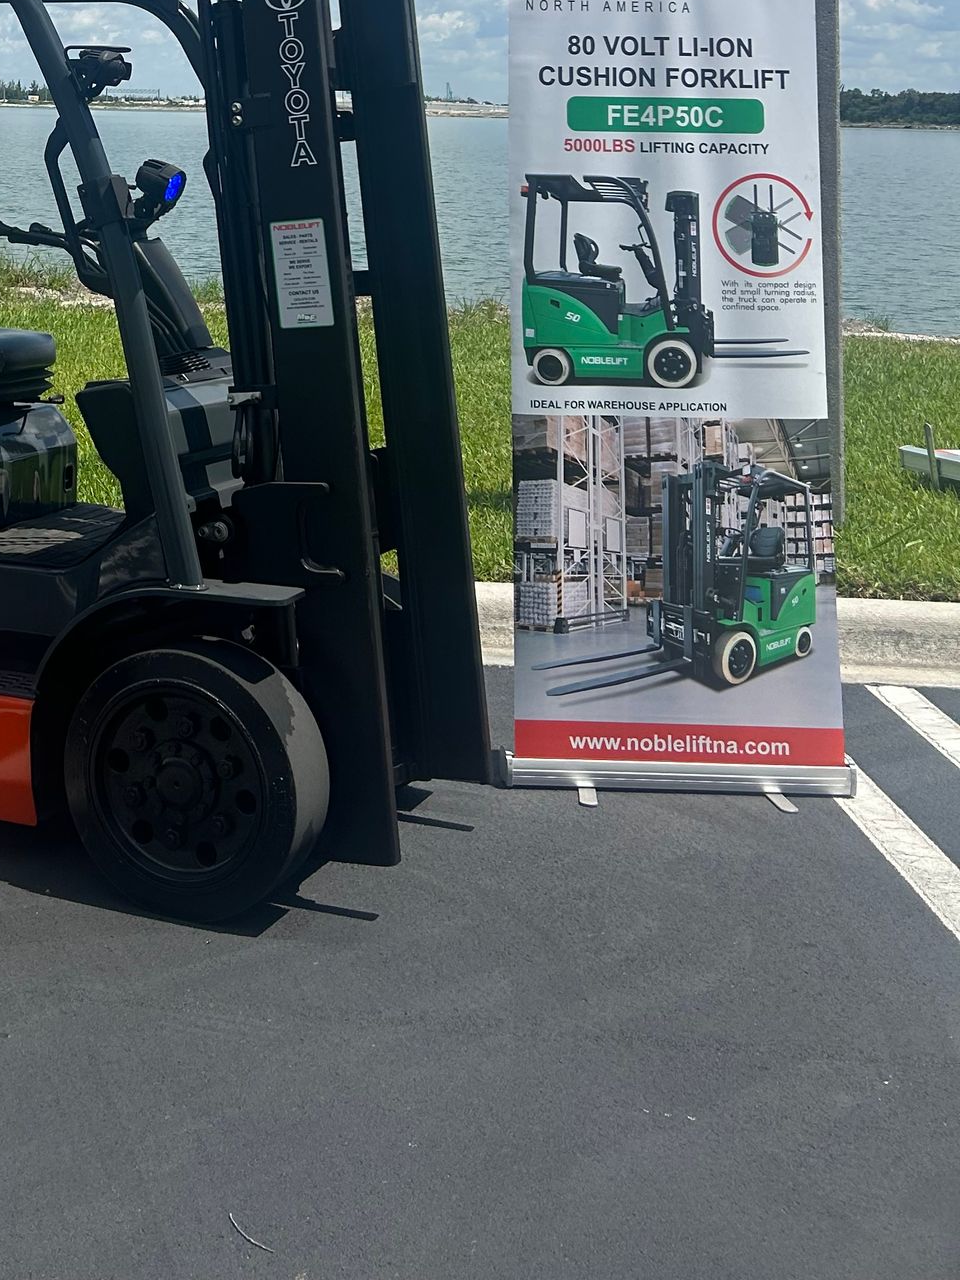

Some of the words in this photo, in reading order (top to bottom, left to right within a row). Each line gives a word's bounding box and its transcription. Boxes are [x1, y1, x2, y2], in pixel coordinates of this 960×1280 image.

[525, 0, 590, 11] NORTH
[603, 0, 690, 13] AMERICA
[567, 35, 595, 56] 80
[603, 35, 670, 57] VOLT
[678, 37, 753, 58] LI-ION
[538, 66, 656, 87] CUSHION
[666, 68, 790, 90] FORKLIFT
[278, 12, 317, 167] TOYOTA
[606, 105, 724, 128] FE4P50C
[563, 138, 636, 154] 5000LBS
[640, 141, 696, 154] LIFTING
[698, 142, 770, 156] CAPACITY
[721, 280, 739, 288] With
[794, 281, 816, 290] design
[740, 288, 760, 296] small
[764, 289, 790, 297] turning
[793, 289, 816, 297] radius,
[779, 296, 807, 305] operate
[564, 311, 581, 323] 50
[580, 355, 629, 366] NOBLELIFT
[529, 399, 561, 409] IDEAL
[564, 400, 586, 410] FOR
[588, 400, 656, 411] WAREHOUSE
[658, 402, 727, 412] APPLICATION
[569, 732, 791, 756] www.nobleliftna.com
